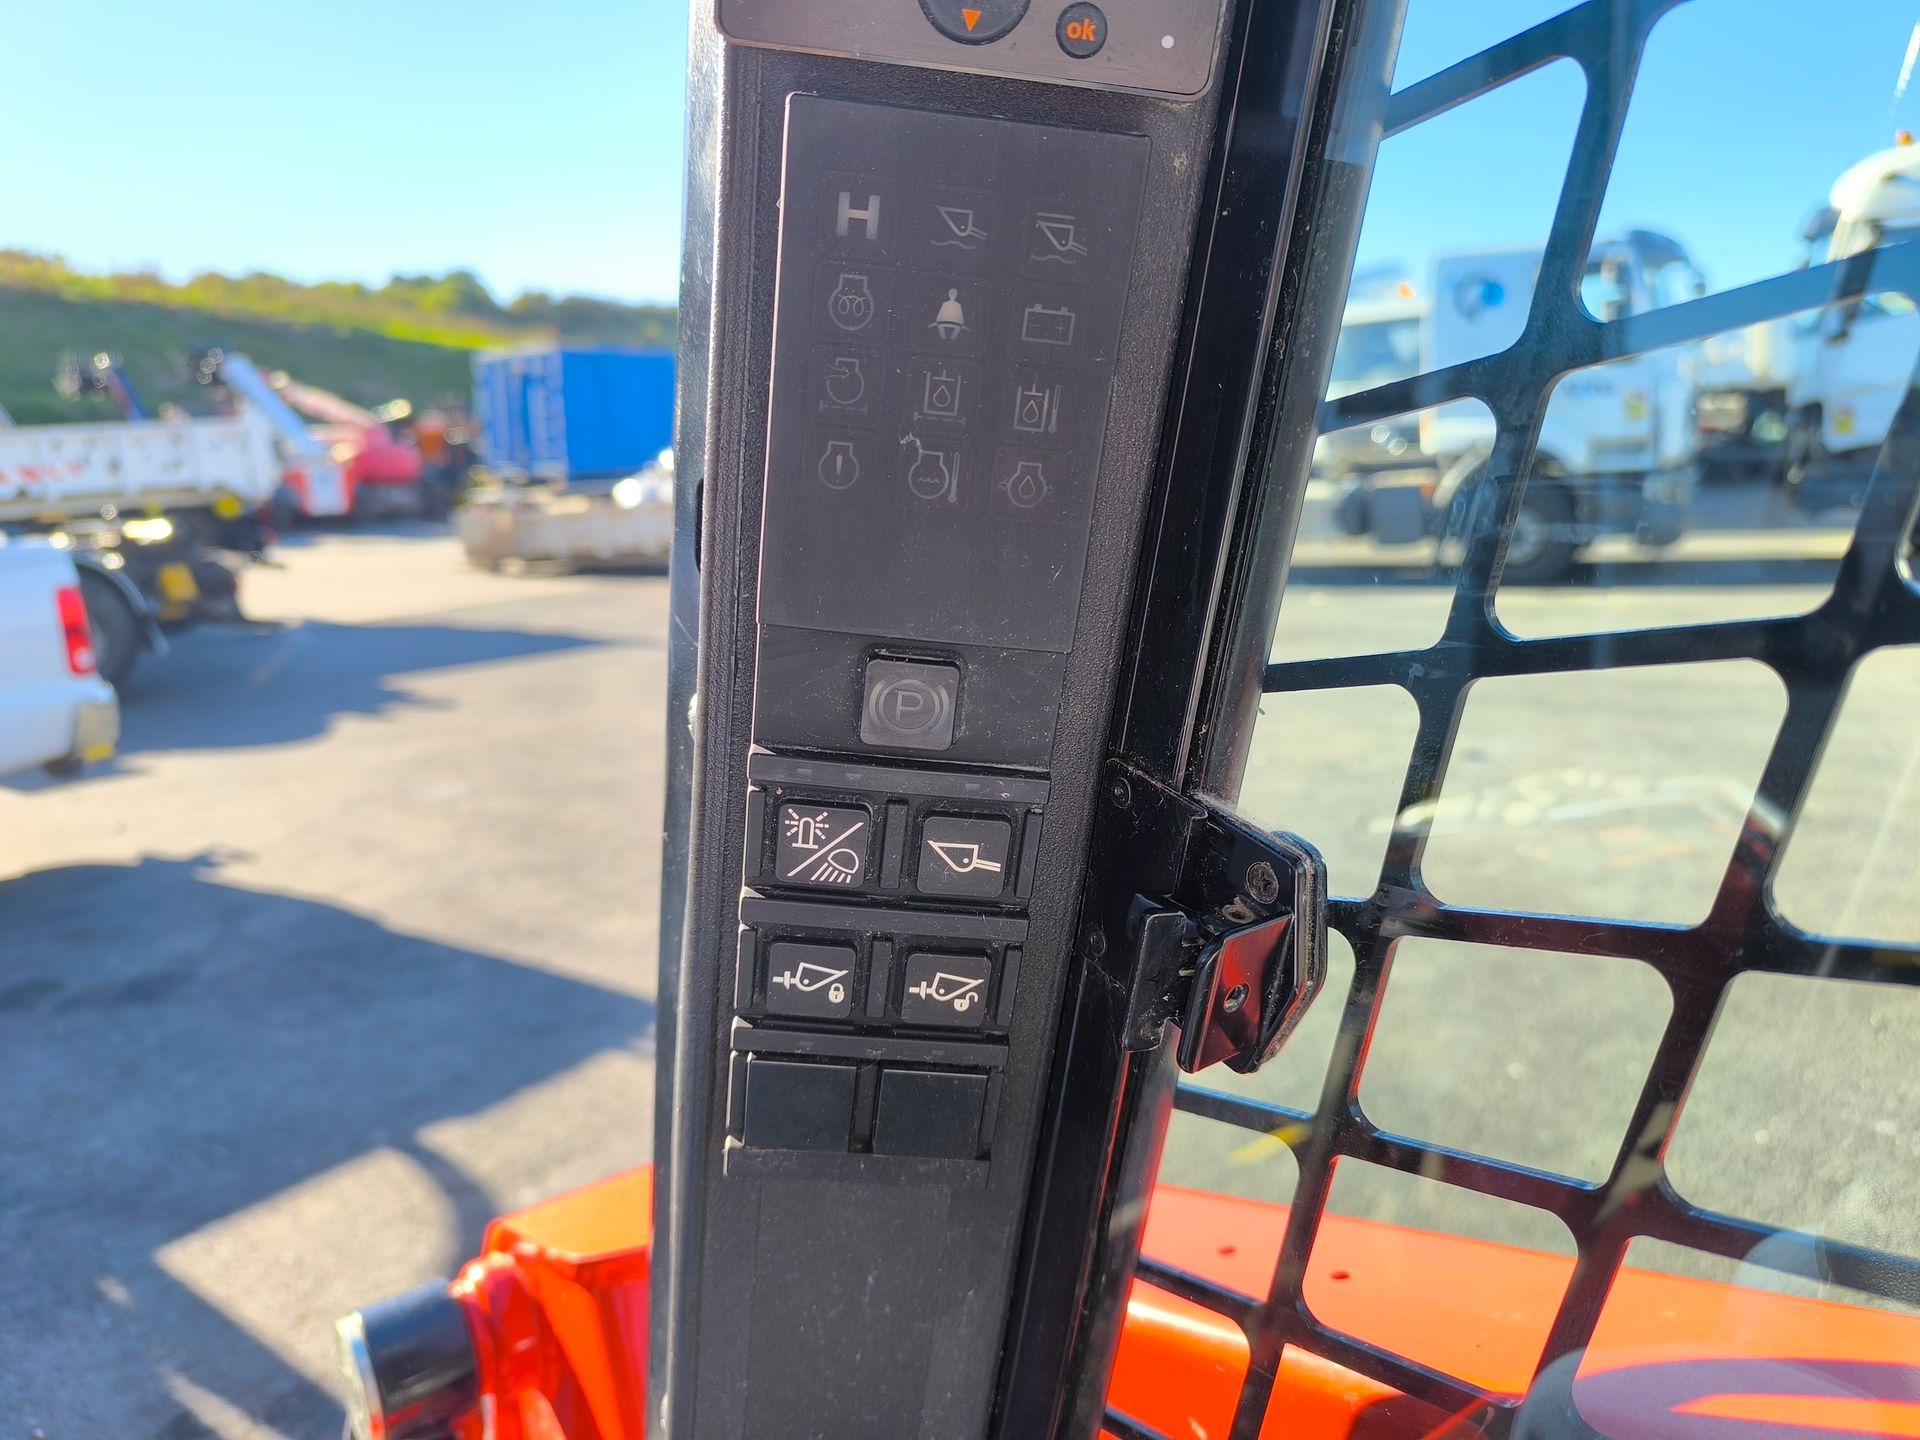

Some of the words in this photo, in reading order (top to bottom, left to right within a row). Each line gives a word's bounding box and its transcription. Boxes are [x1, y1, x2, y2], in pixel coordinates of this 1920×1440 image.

[1066, 18, 1097, 41] ok
[836, 191, 880, 240] H
[895, 689, 924, 721] P
